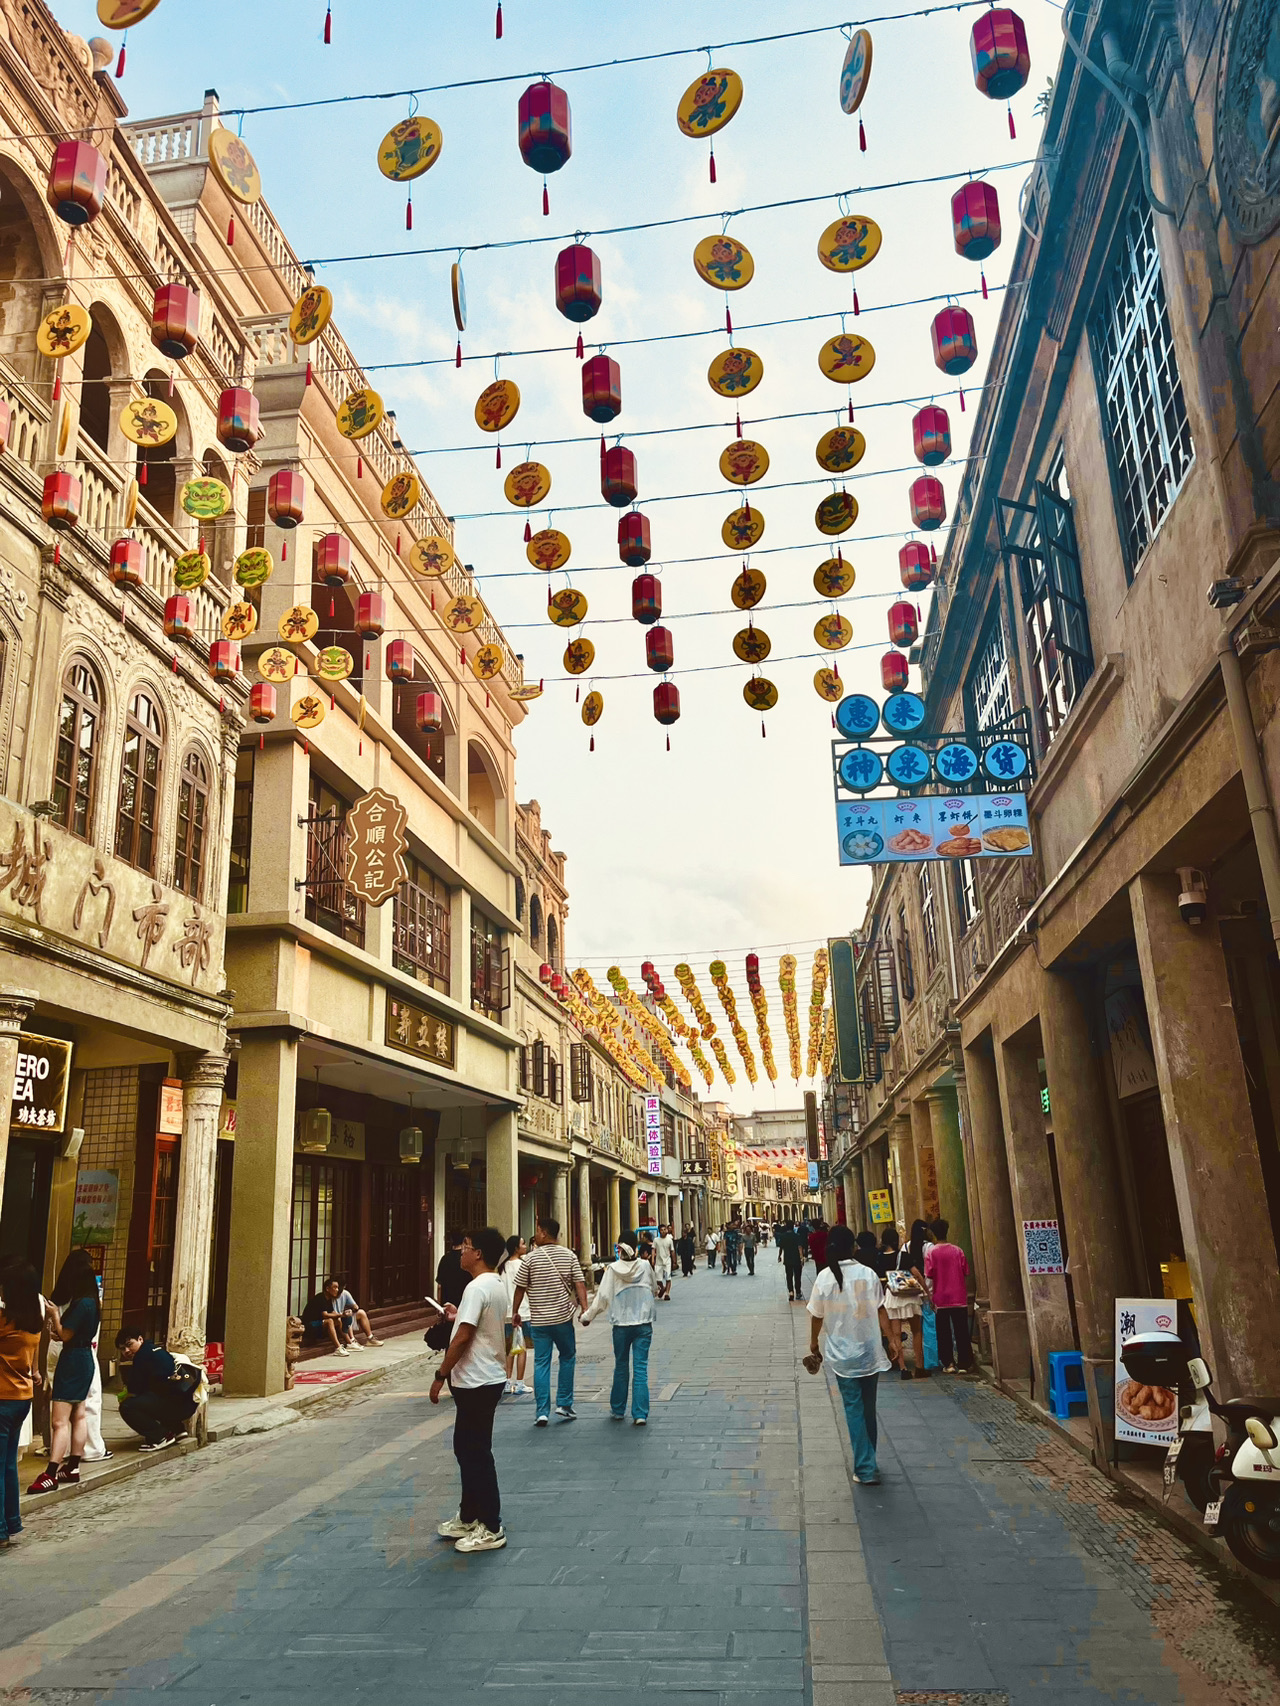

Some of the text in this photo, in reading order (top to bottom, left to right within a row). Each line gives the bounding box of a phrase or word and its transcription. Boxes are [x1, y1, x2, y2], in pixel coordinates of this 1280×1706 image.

[846, 698, 921, 728] 惠来
[846, 745, 1018, 784] 神泉海货
[843, 815, 878, 827] 墨斗丸
[364, 802, 387, 889] 合順公記
[16, 1053, 50, 1080] ERO
[12, 1077, 34, 1102] EA
[17, 1105, 56, 1127] 功夫茶坊
